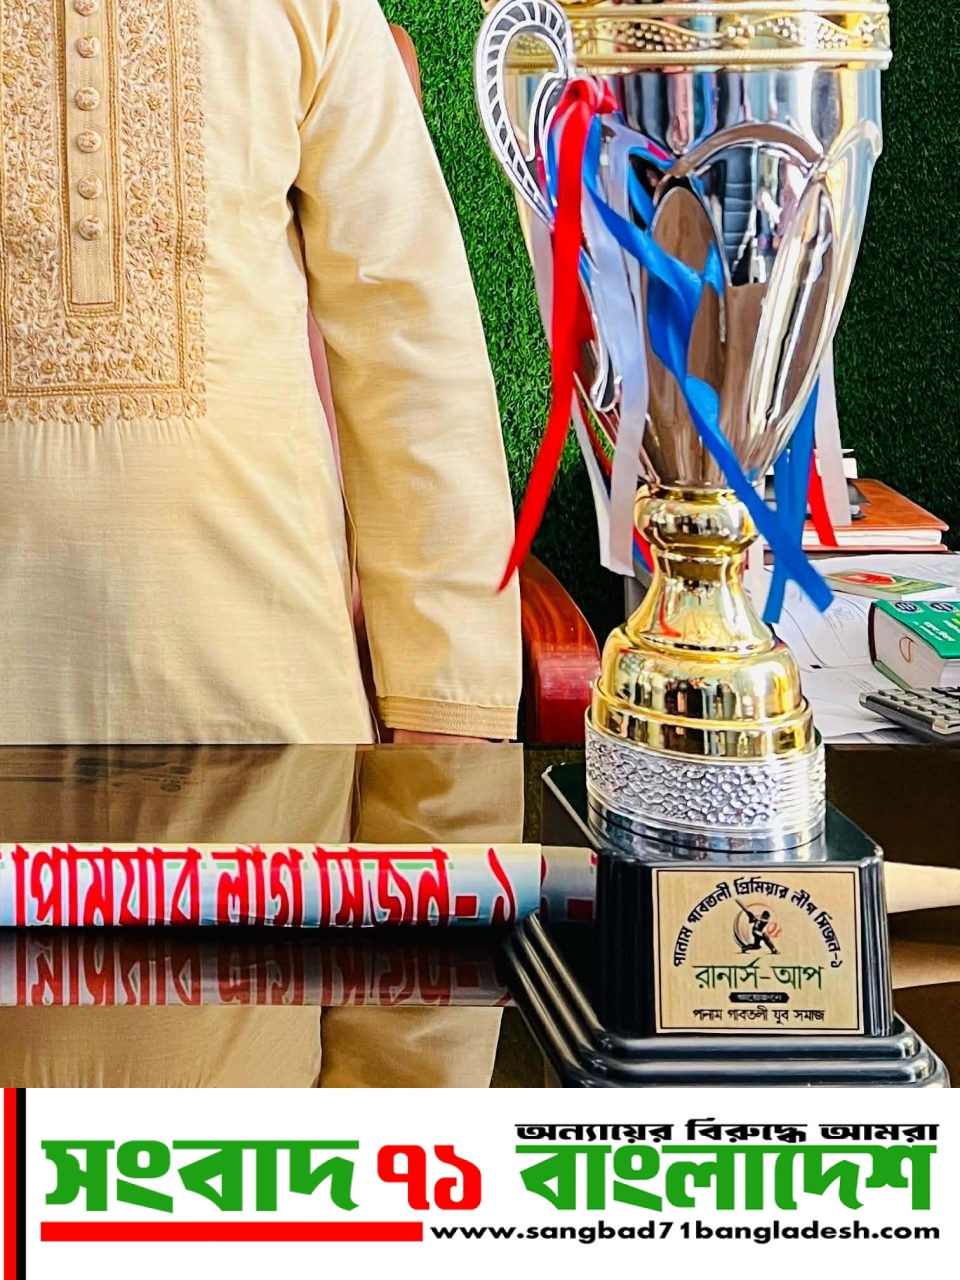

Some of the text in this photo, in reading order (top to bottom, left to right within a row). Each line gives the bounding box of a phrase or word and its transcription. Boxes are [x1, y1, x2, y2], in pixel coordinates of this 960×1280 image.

[691, 957, 825, 990] রানার্স-আপ
[771, 1009, 789, 1025] যুব
[793, 1009, 825, 1022] সমাজ
